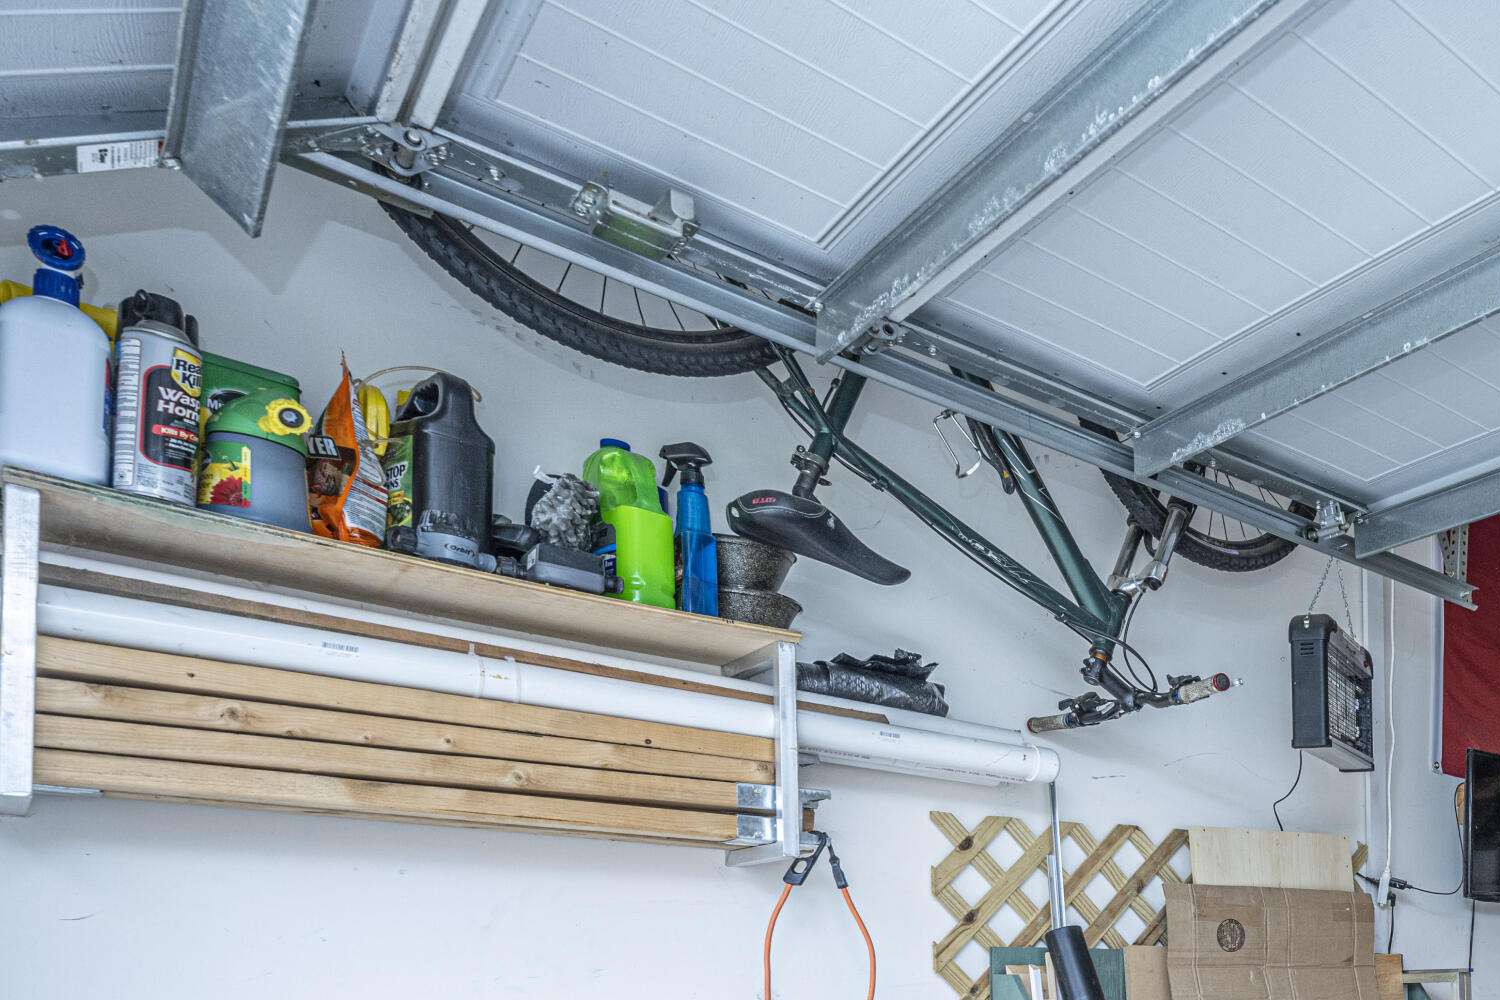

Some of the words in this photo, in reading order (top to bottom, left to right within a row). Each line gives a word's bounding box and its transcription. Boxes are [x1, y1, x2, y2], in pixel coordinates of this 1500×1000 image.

[175, 358, 201, 373] Rea
[181, 371, 201, 388] Kil
[158, 386, 200, 411] Wasp
[157, 400, 200, 422] Horn
[385, 464, 406, 481] STOP
